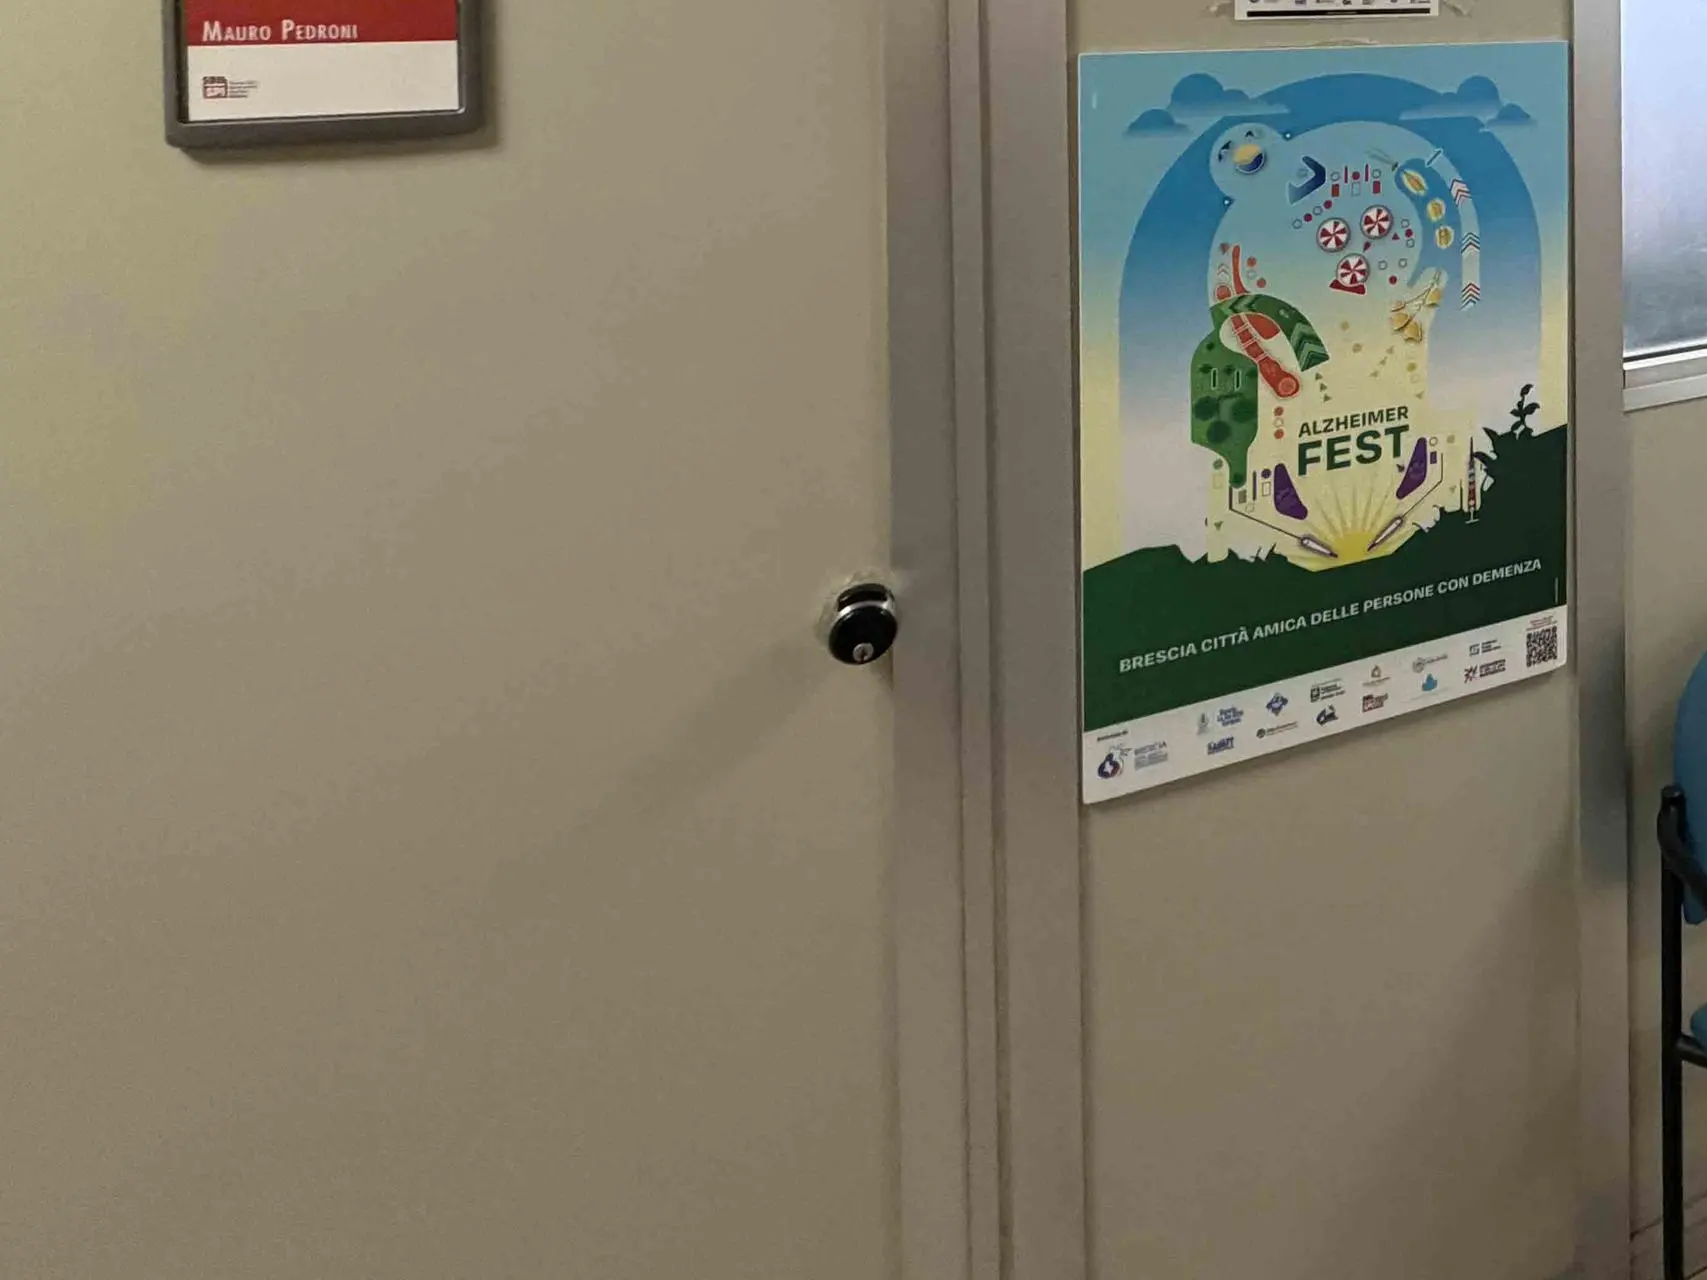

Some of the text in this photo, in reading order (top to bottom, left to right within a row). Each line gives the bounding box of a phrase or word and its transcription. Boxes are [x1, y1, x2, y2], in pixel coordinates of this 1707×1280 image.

[1298, 406, 1409, 438] ALZHEIMER
[1298, 424, 1410, 476] FEST
[1119, 558, 1542, 673] BRESCIA CITTÀ AMICA DELLE PERSONE CON DEMENZA
